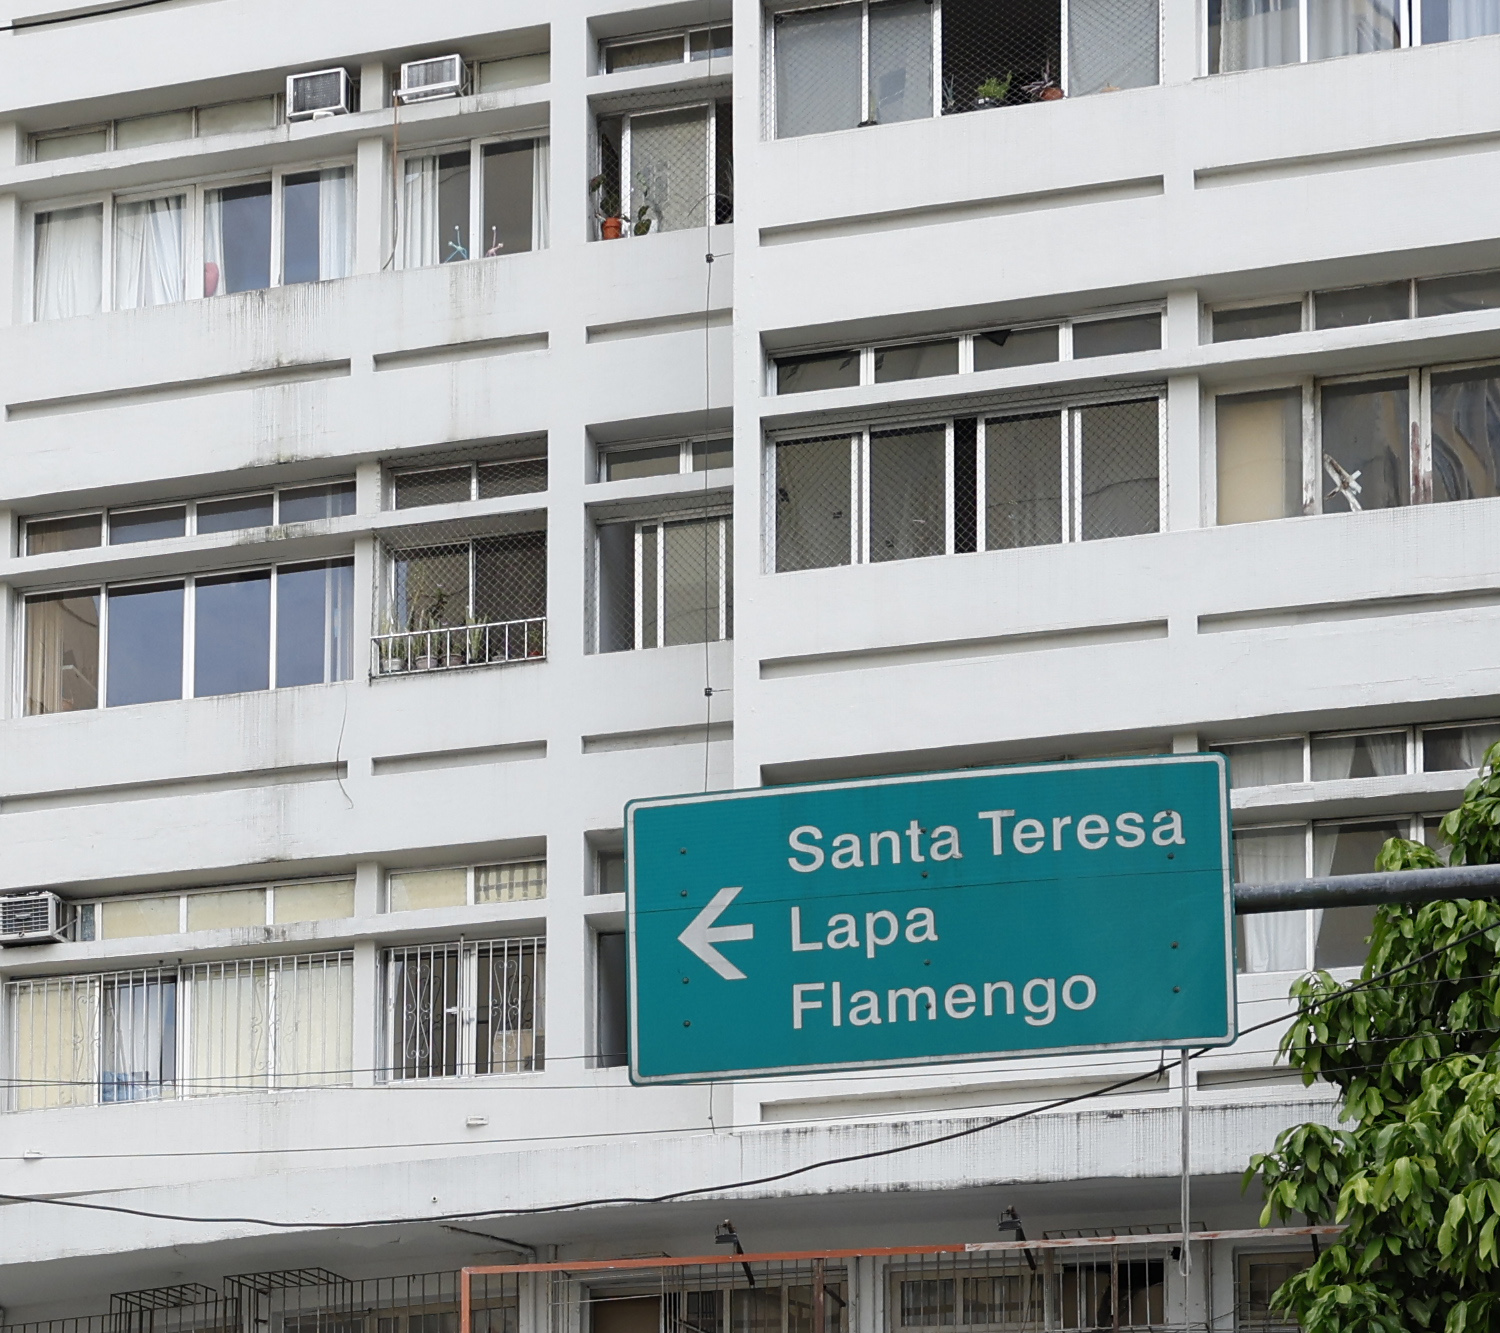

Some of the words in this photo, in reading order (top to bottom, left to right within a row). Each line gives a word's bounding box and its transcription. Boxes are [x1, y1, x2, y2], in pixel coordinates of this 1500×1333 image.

[787, 818, 963, 874] Santa
[977, 807, 1187, 857] Teresa
[790, 902, 939, 960] Lapa
[791, 972, 1098, 1030] Flamengo
